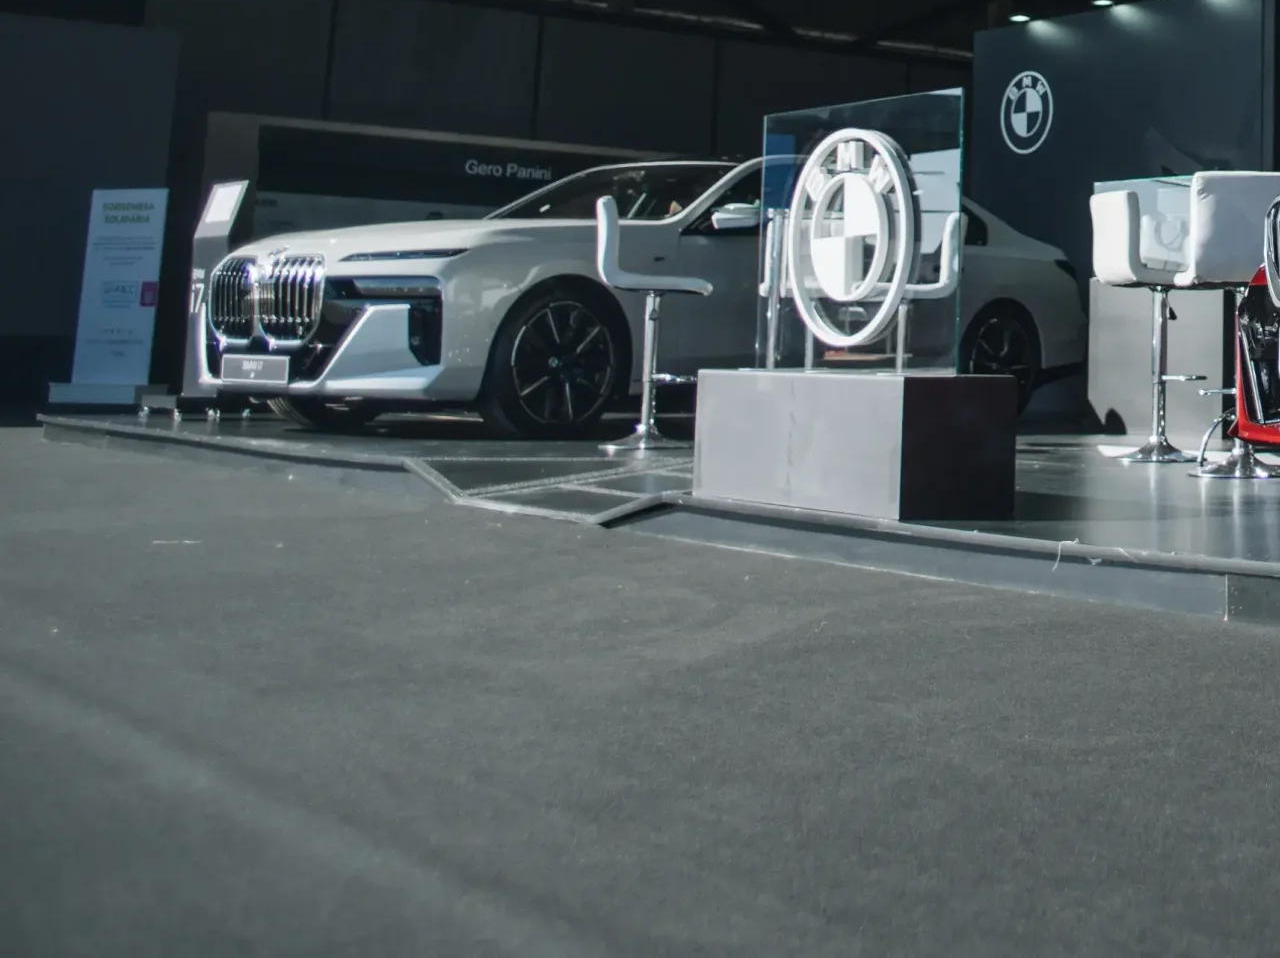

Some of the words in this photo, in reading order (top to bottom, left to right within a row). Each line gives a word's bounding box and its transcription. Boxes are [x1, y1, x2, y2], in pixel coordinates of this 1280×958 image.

[465, 159, 503, 178] Gero
[505, 163, 553, 181] Panini
[190, 283, 206, 313] i7
